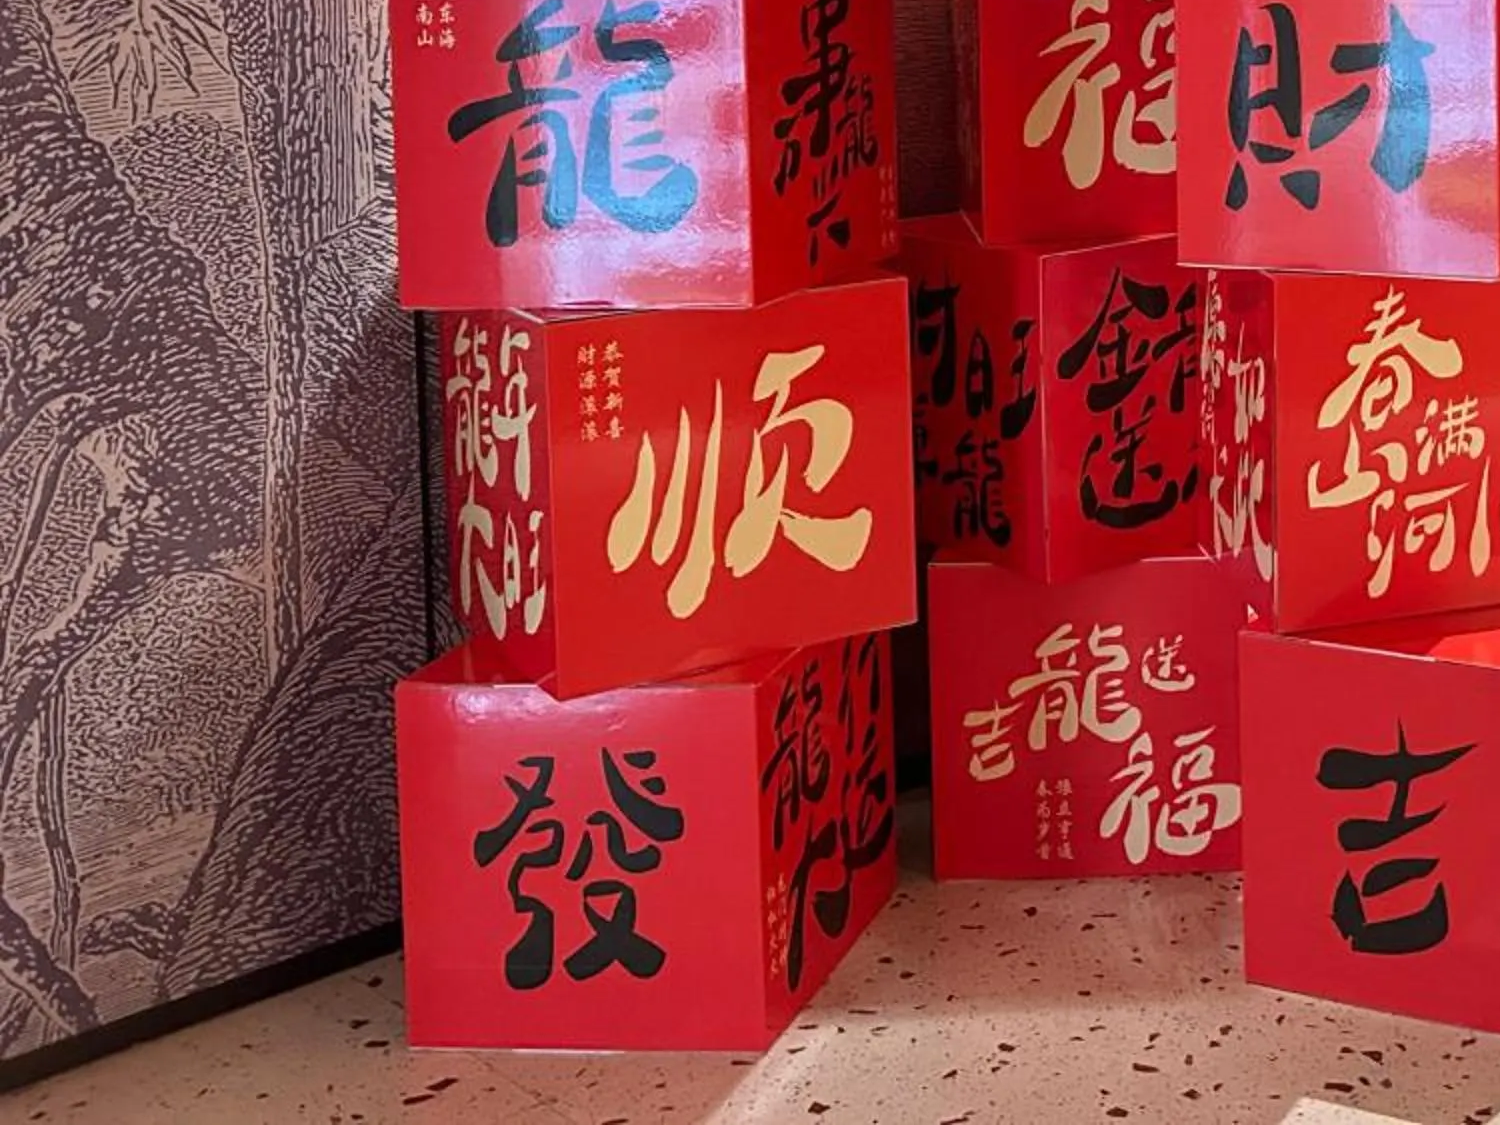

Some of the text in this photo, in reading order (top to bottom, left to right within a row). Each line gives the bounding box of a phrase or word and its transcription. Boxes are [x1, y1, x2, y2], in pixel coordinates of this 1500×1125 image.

[1224, 2, 1436, 212] 財
[473, 746, 685, 990] 發
[1315, 716, 1479, 956] 吉
